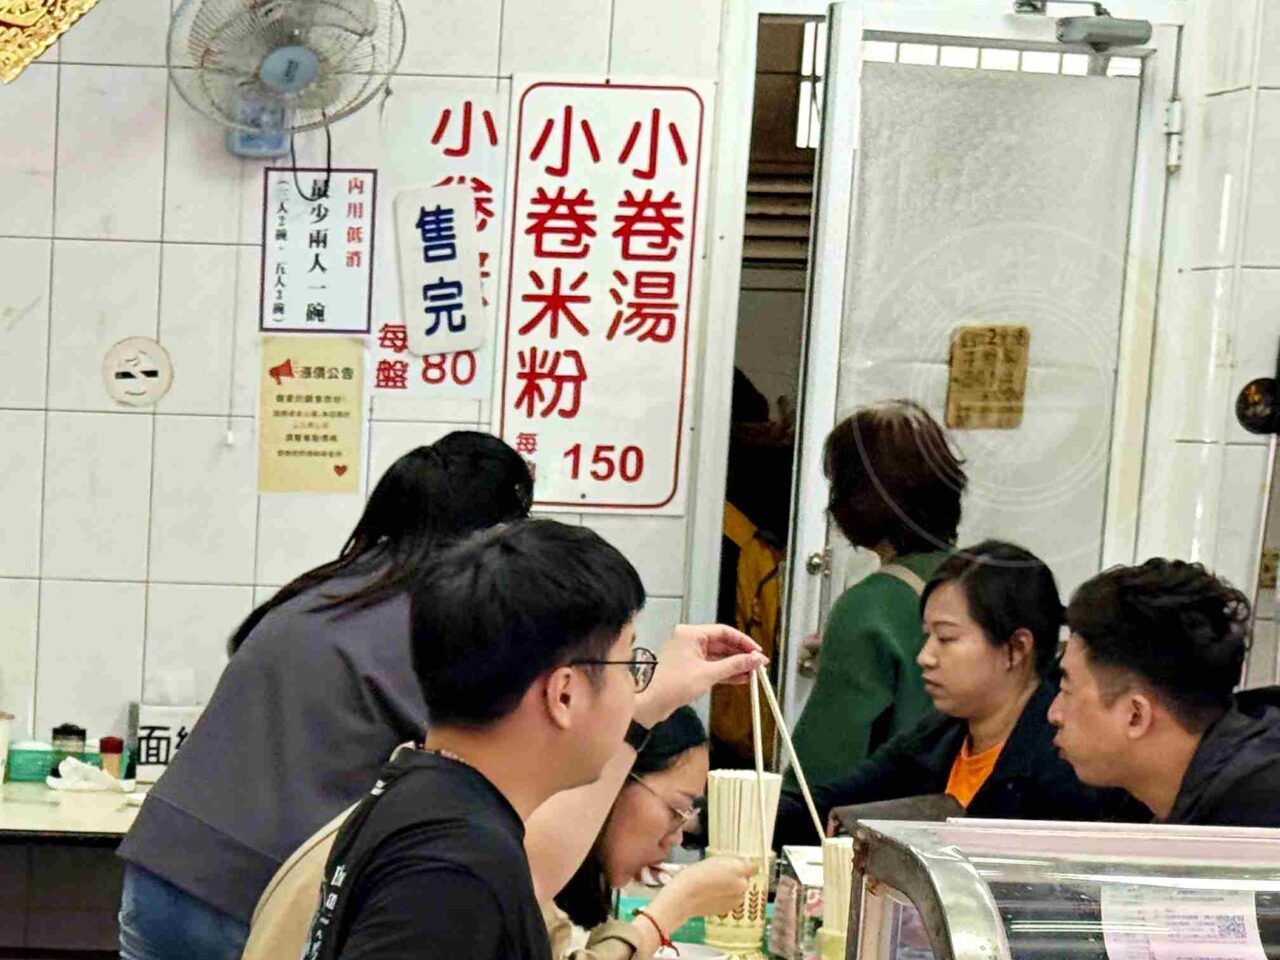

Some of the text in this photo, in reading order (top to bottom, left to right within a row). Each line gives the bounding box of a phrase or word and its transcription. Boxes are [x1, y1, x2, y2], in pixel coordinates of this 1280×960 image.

[415, 204, 466, 336] 售完
[515, 105, 601, 420] 小卷米粉
[607, 108, 688, 343] 小卷湯
[421, 350, 477, 386] 80
[563, 443, 645, 483] 150
